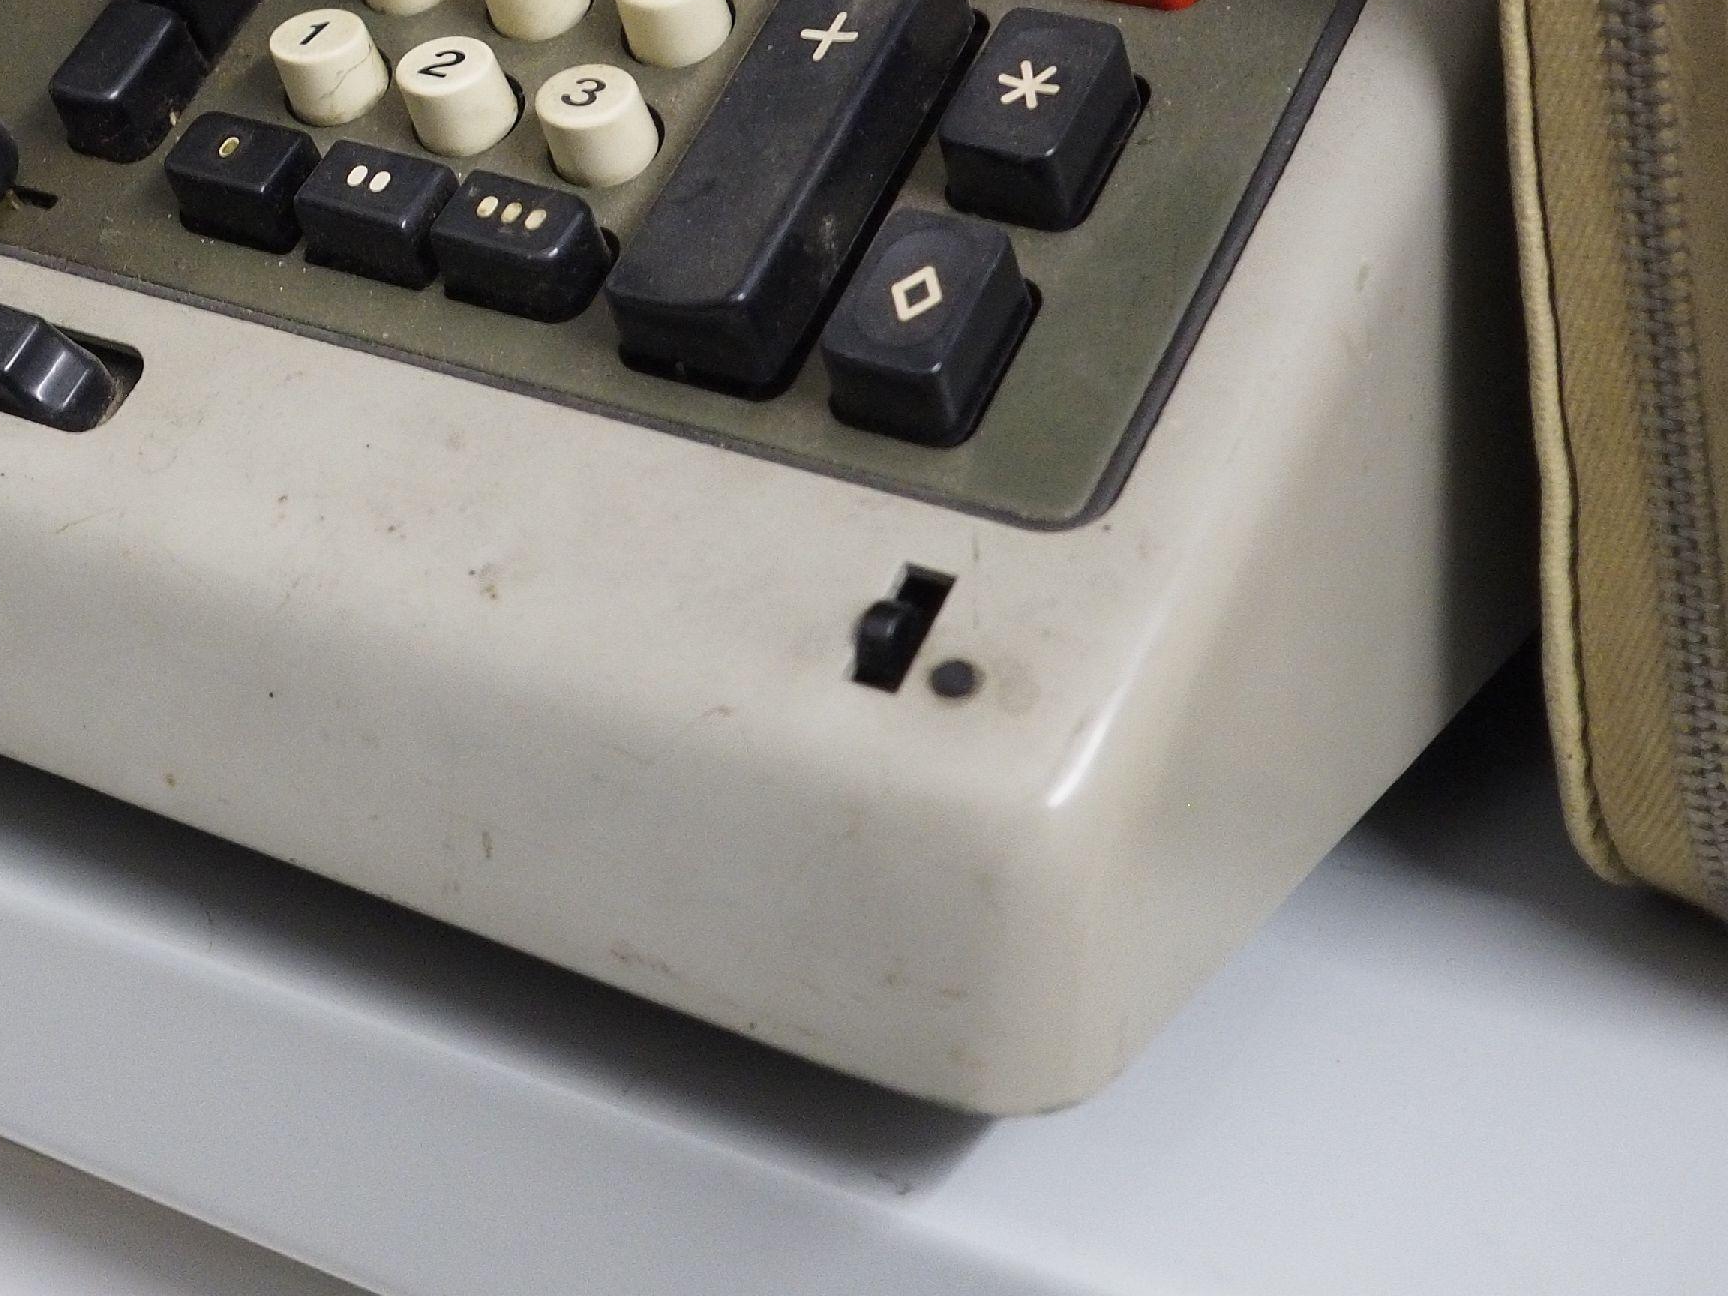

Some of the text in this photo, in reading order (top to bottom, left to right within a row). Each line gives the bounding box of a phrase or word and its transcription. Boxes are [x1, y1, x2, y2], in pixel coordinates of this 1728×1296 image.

[299, 22, 331, 47] 1
[418, 50, 466, 78] 2
[560, 77, 607, 106] 3
